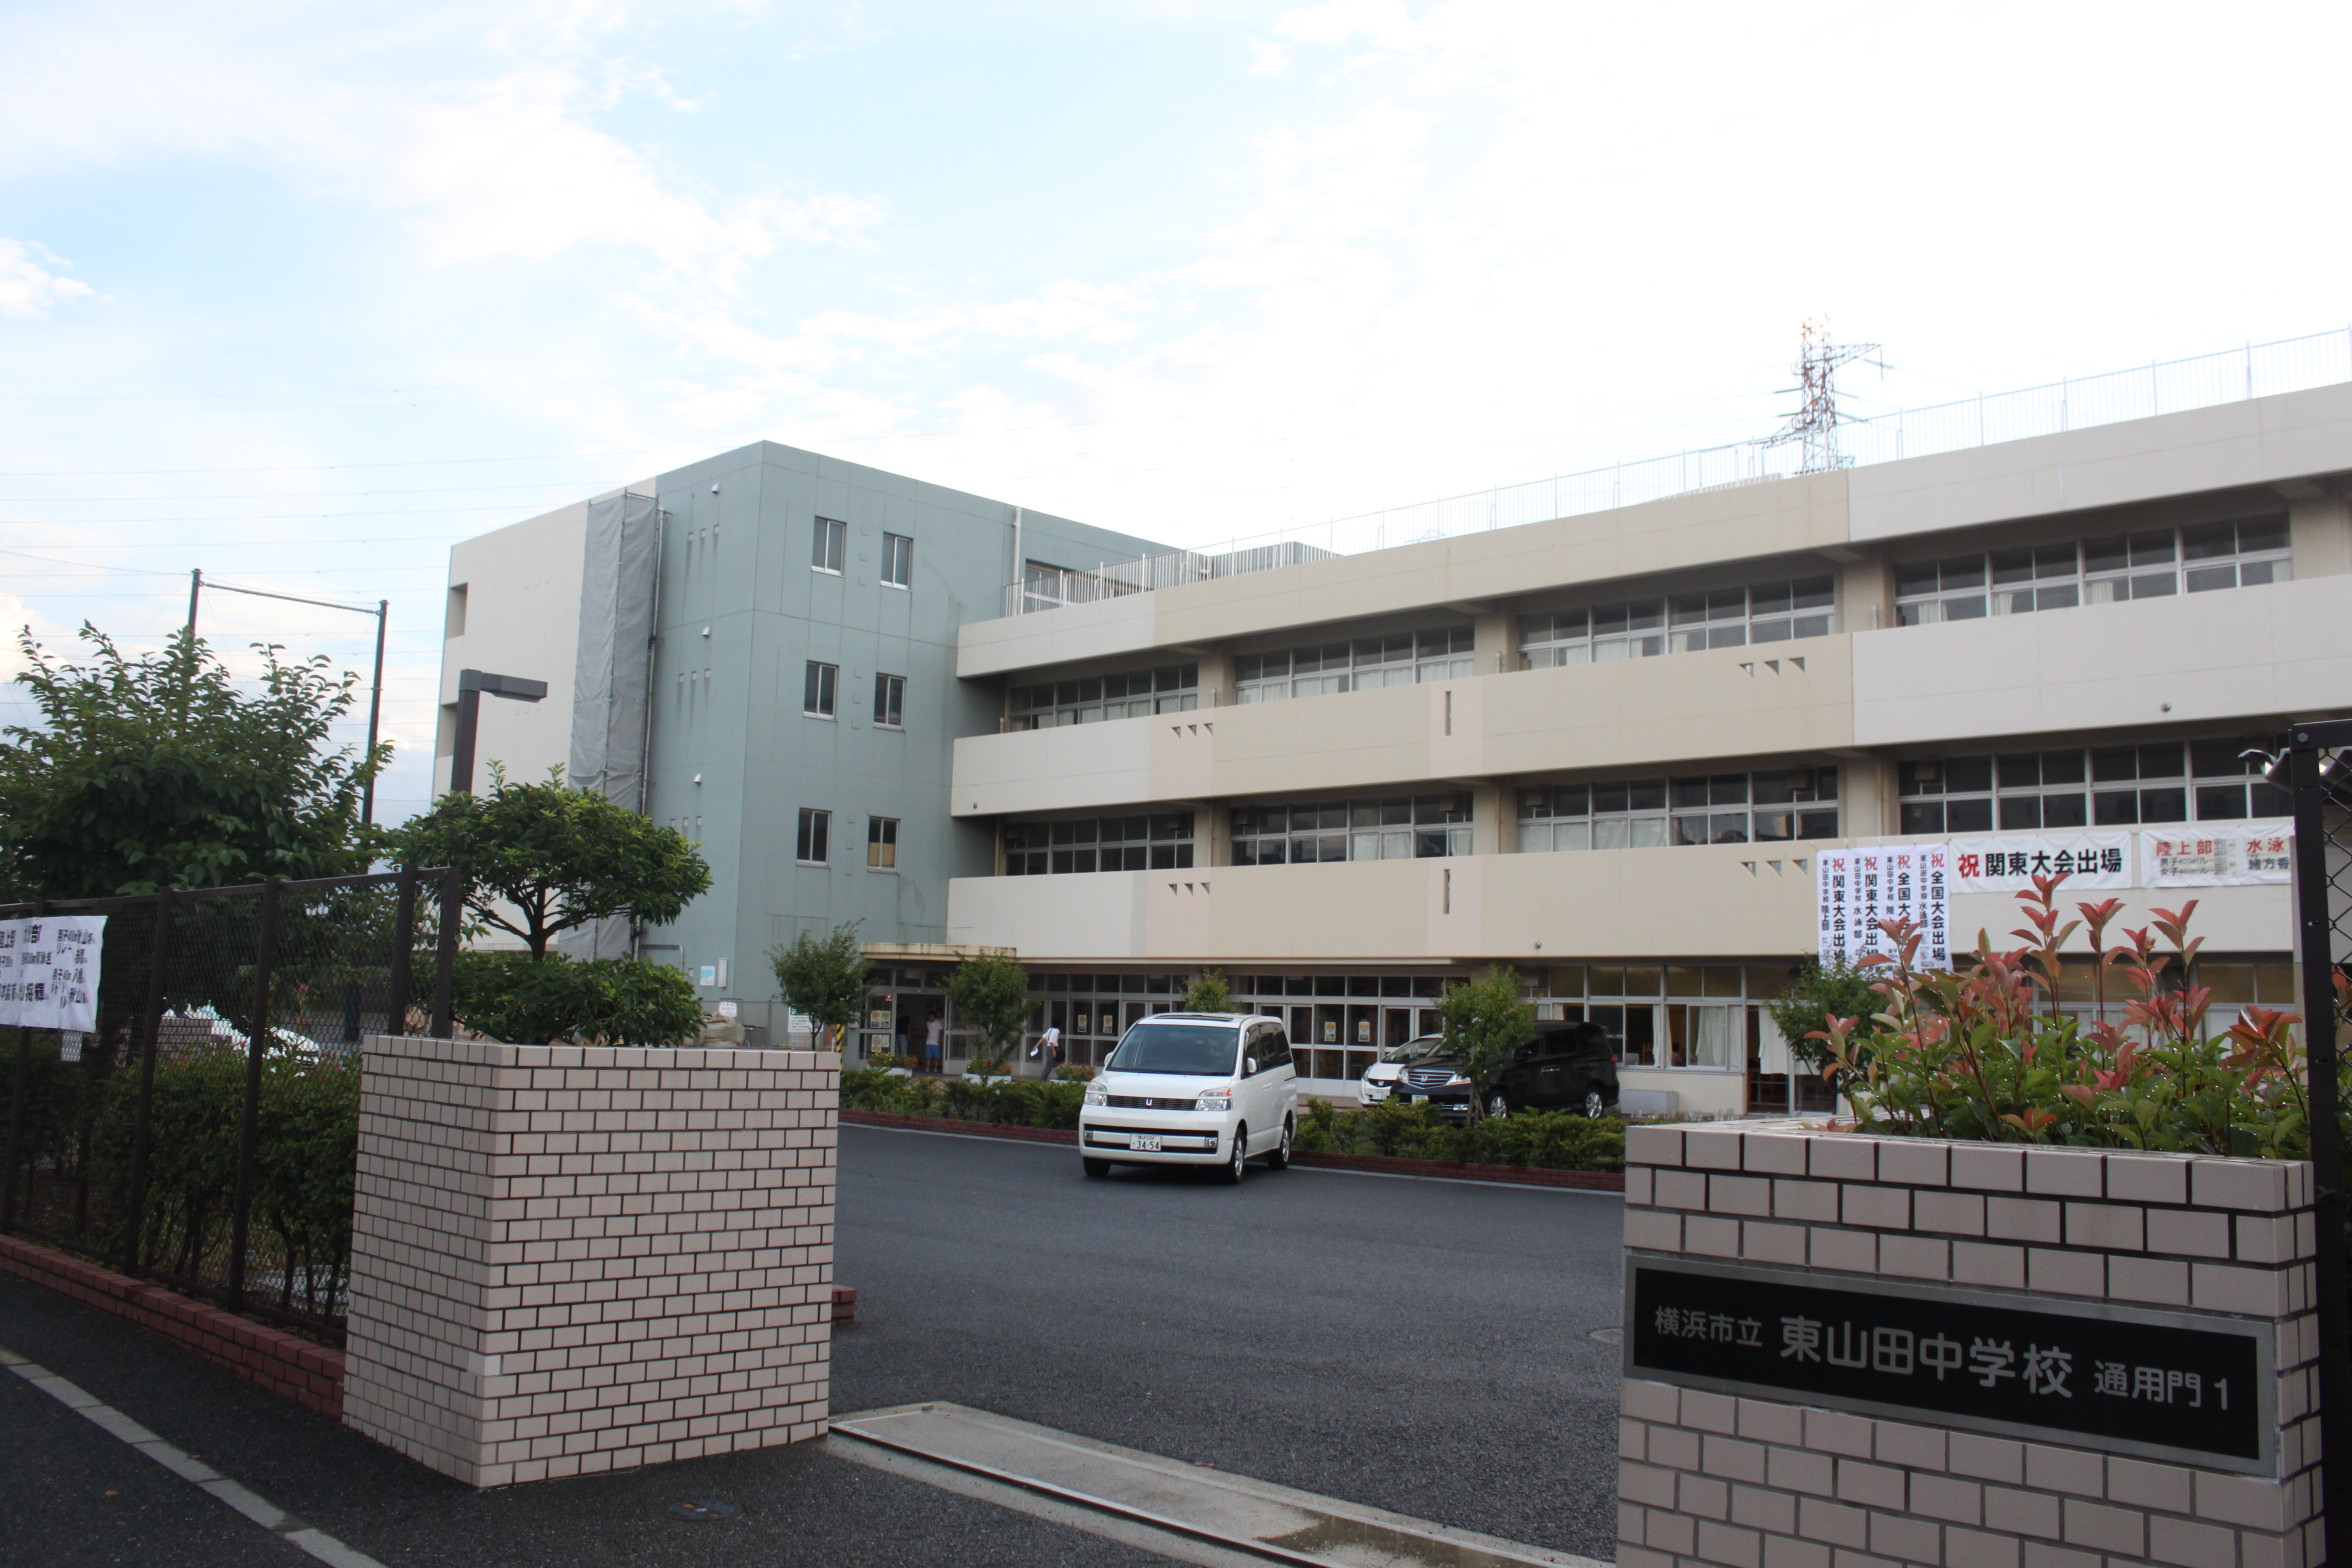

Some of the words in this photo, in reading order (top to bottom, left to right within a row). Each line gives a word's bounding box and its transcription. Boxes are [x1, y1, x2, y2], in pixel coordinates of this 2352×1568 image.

[2157, 840, 2212, 857] 陸上部
[2247, 837, 2290, 854] 水泳
[1136, 1140, 1159, 1150] 34-54
[1654, 1305, 1764, 1348] 横浜市立
[1780, 1316, 2075, 1399] 東山田中学校
